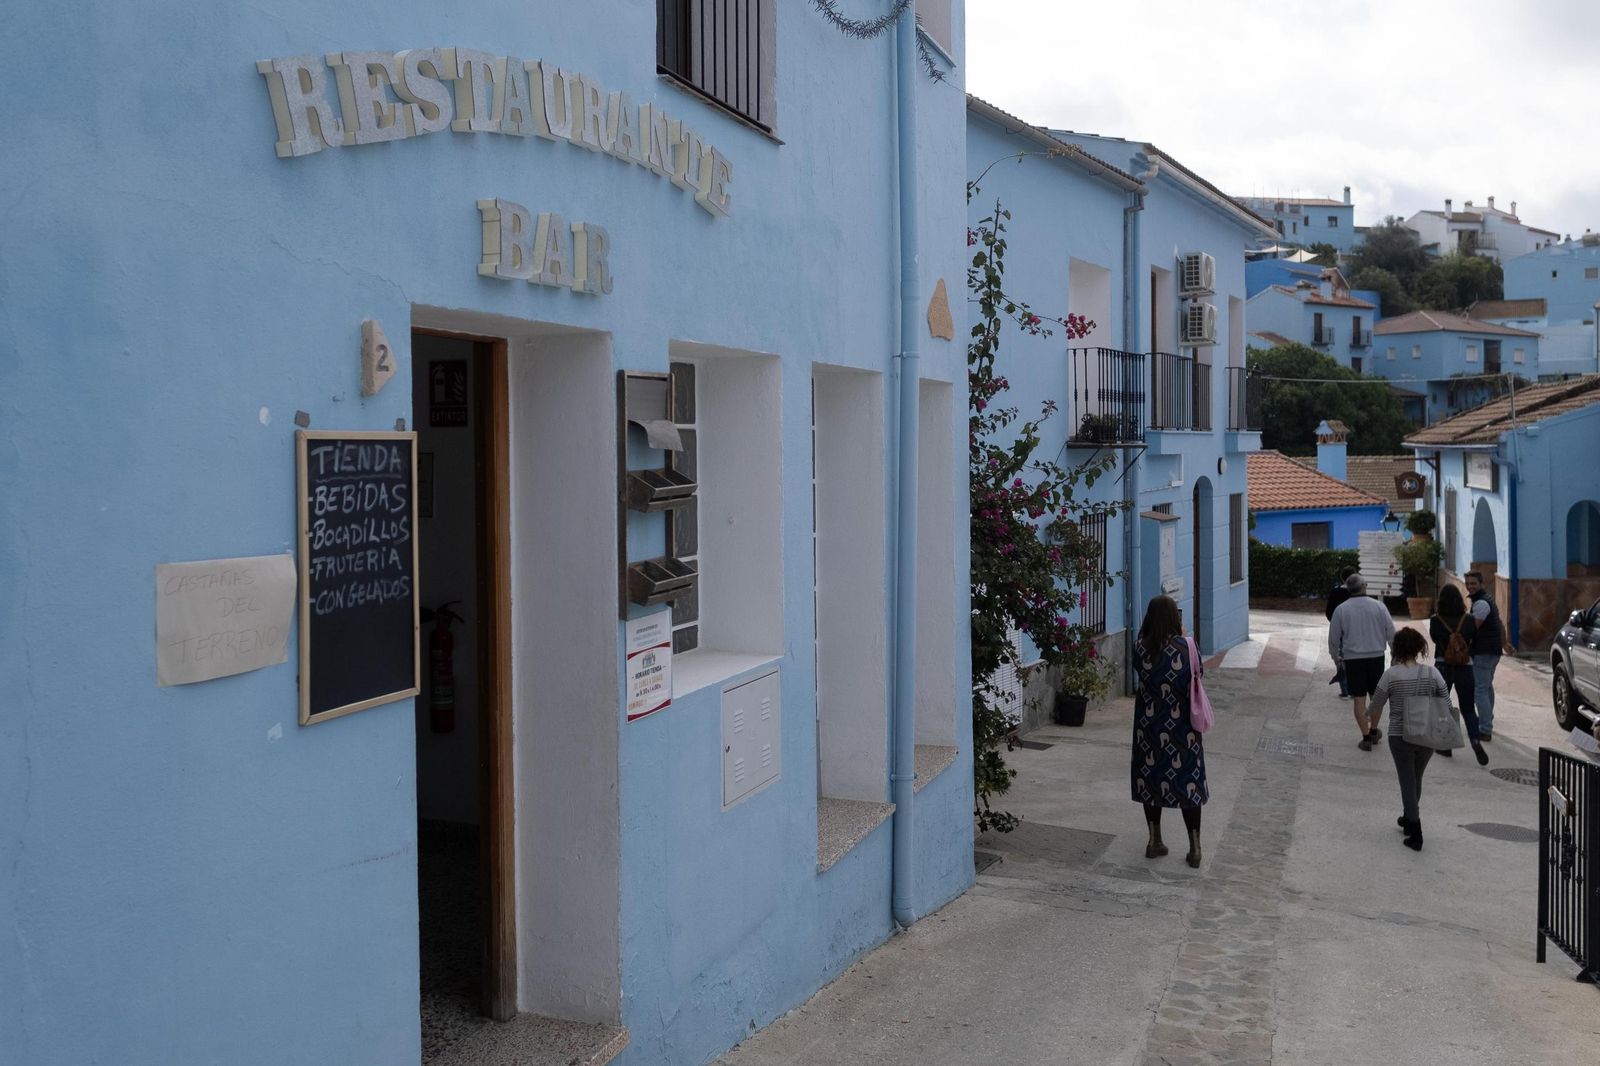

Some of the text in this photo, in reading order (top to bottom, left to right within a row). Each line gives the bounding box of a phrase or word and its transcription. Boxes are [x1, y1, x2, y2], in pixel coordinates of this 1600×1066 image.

[256, 46, 733, 217] RESTAURANTE
[477, 197, 613, 295] BAR
[375, 343, 390, 373] 2
[310, 440, 402, 475] TIENDA
[215, 593, 260, 618] DEL
[167, 623, 281, 665] TERRENO
